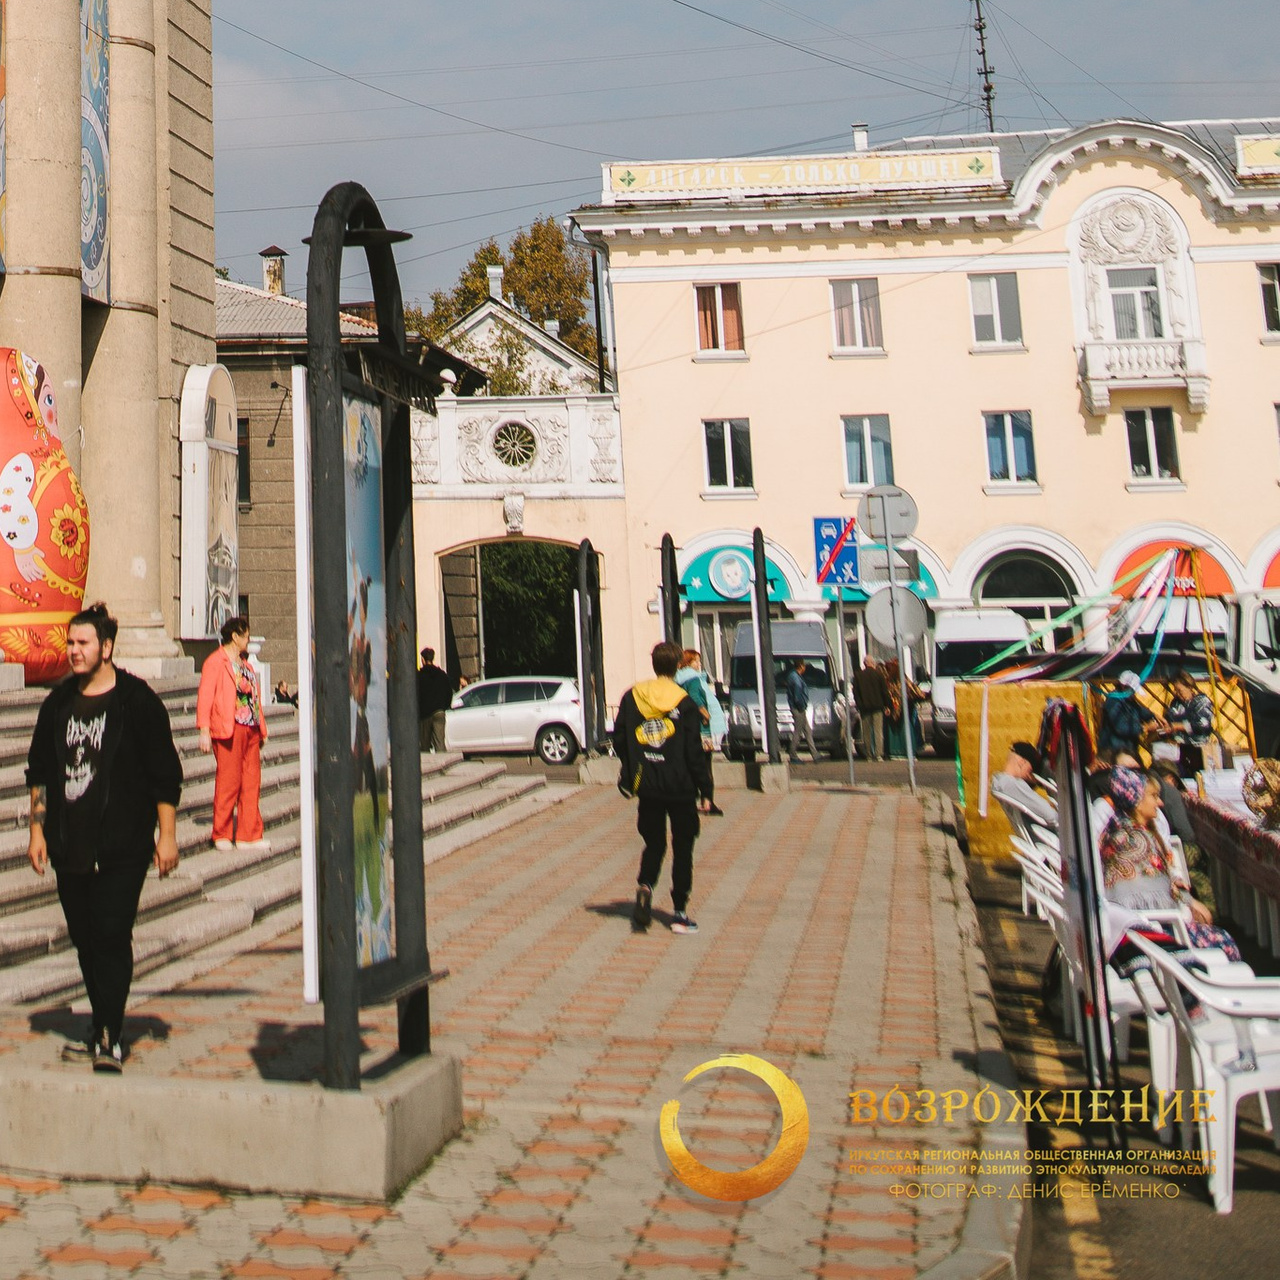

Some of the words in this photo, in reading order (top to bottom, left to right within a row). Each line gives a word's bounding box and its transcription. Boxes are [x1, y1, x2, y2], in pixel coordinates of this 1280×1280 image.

[646, 165, 746, 187] АНГАРСК
[781, 162, 861, 183] ТОЛЬКО
[879, 158, 959, 180] ЛУЧШЕ!
